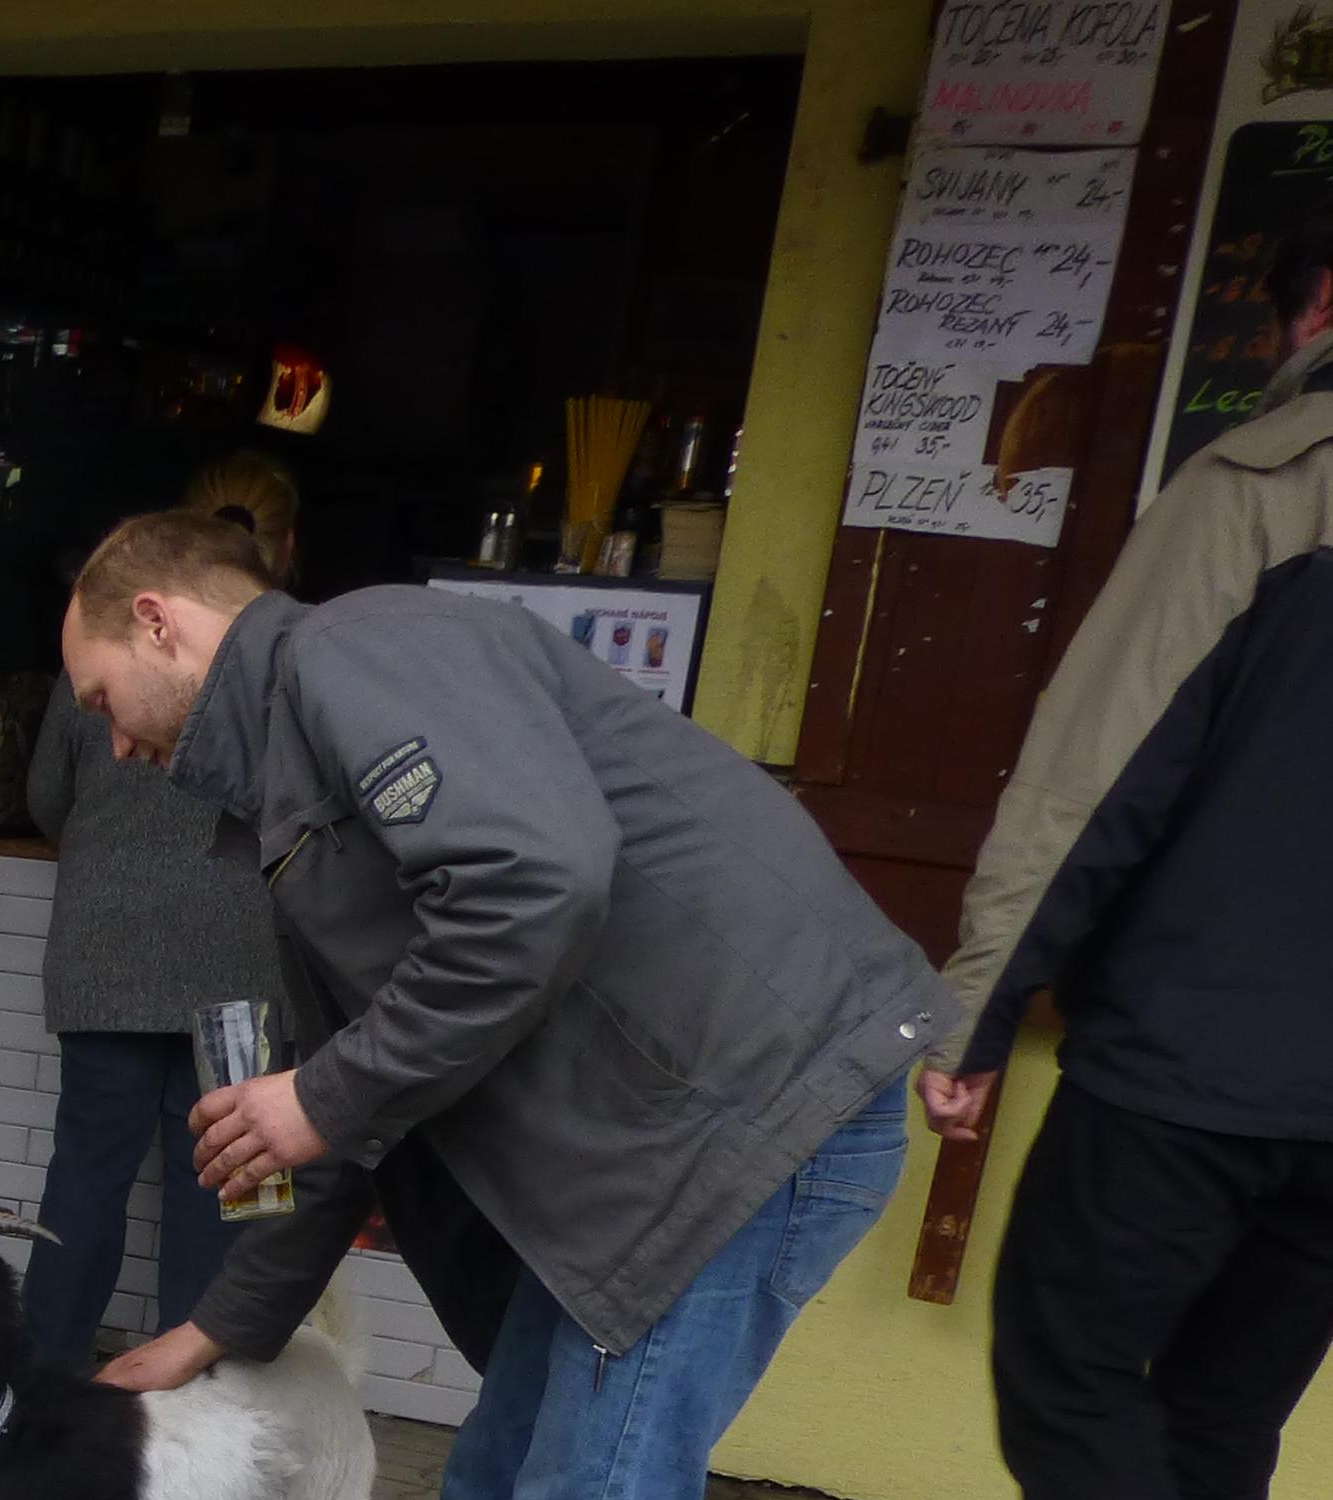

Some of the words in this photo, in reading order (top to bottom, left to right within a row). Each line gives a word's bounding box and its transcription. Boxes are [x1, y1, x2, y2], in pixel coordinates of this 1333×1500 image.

[898, 238, 1022, 275] ROHOZEC
[886, 288, 1003, 315] ROHOZEC
[871, 361, 956, 390] TOČENÝ
[864, 391, 982, 423] KINGSWOOD
[373, 761, 434, 814] BUSHMAN
